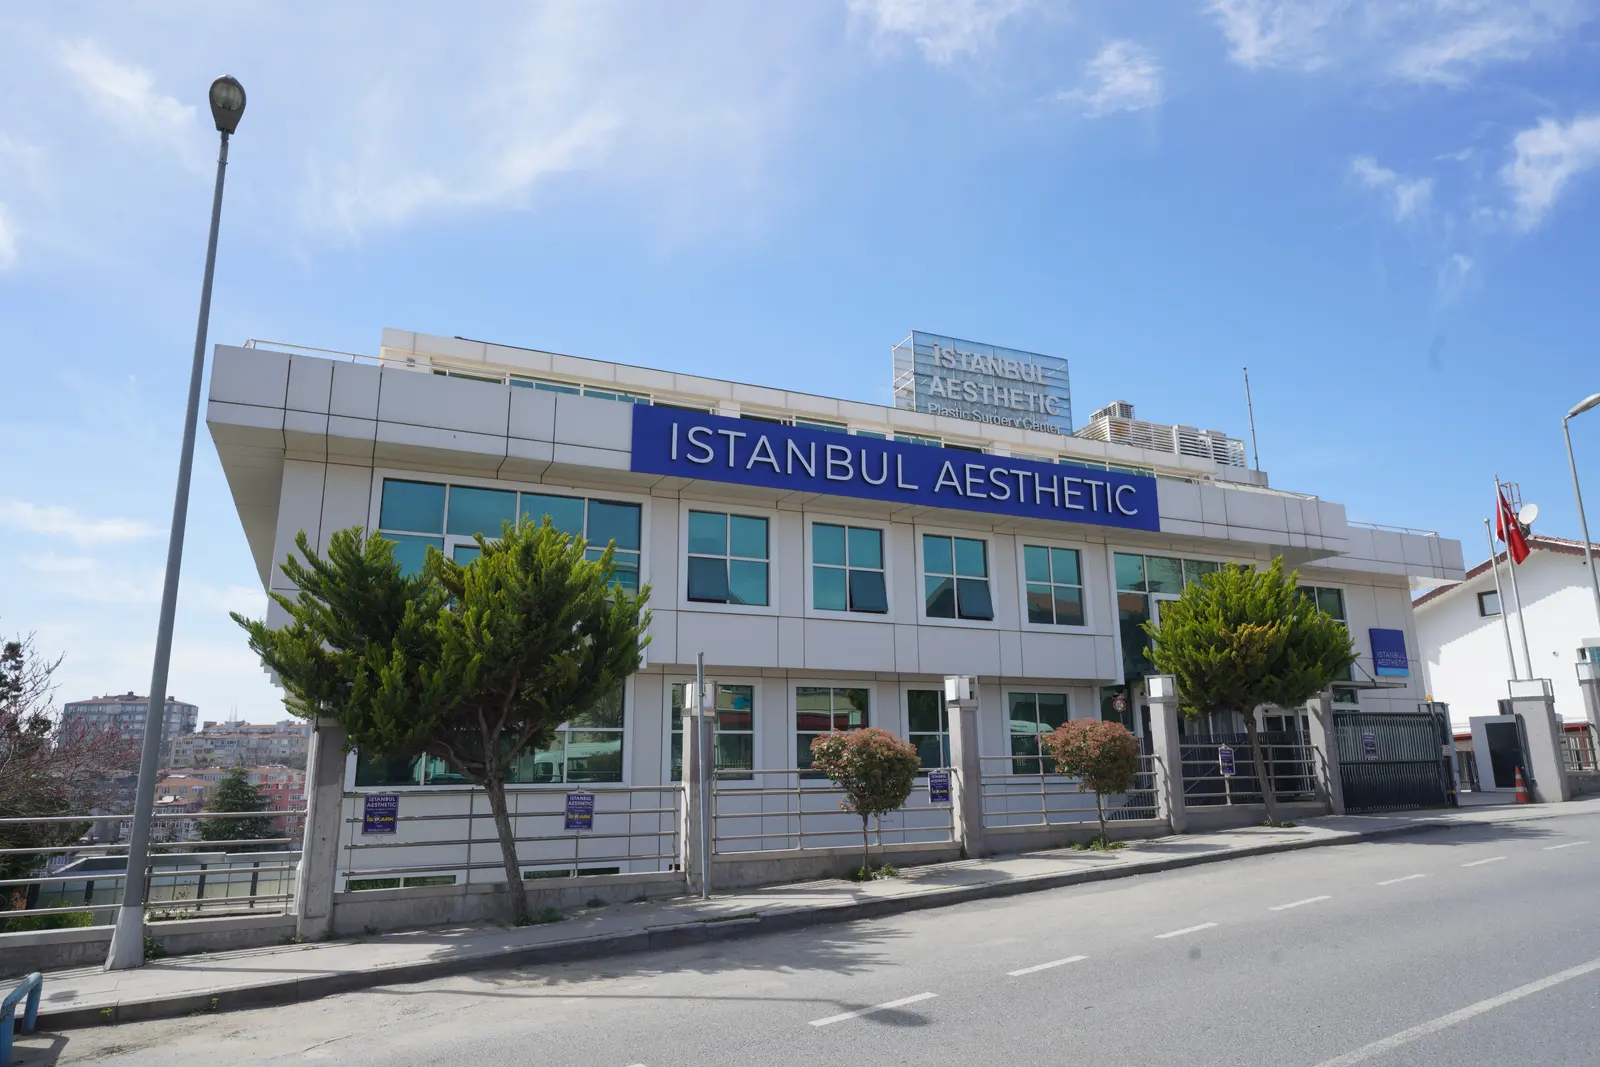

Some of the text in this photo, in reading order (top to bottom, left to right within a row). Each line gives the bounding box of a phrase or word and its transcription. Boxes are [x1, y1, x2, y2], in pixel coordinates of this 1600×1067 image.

[932, 340, 1045, 384] İSTANBUL
[927, 375, 1061, 416] AESTHETIC
[928, 402, 970, 418] Plastic
[1022, 417, 1061, 434] Center
[671, 422, 1139, 516] ISTANBUL AESTHETIC
[1378, 658, 1406, 666] AESTHETIC
